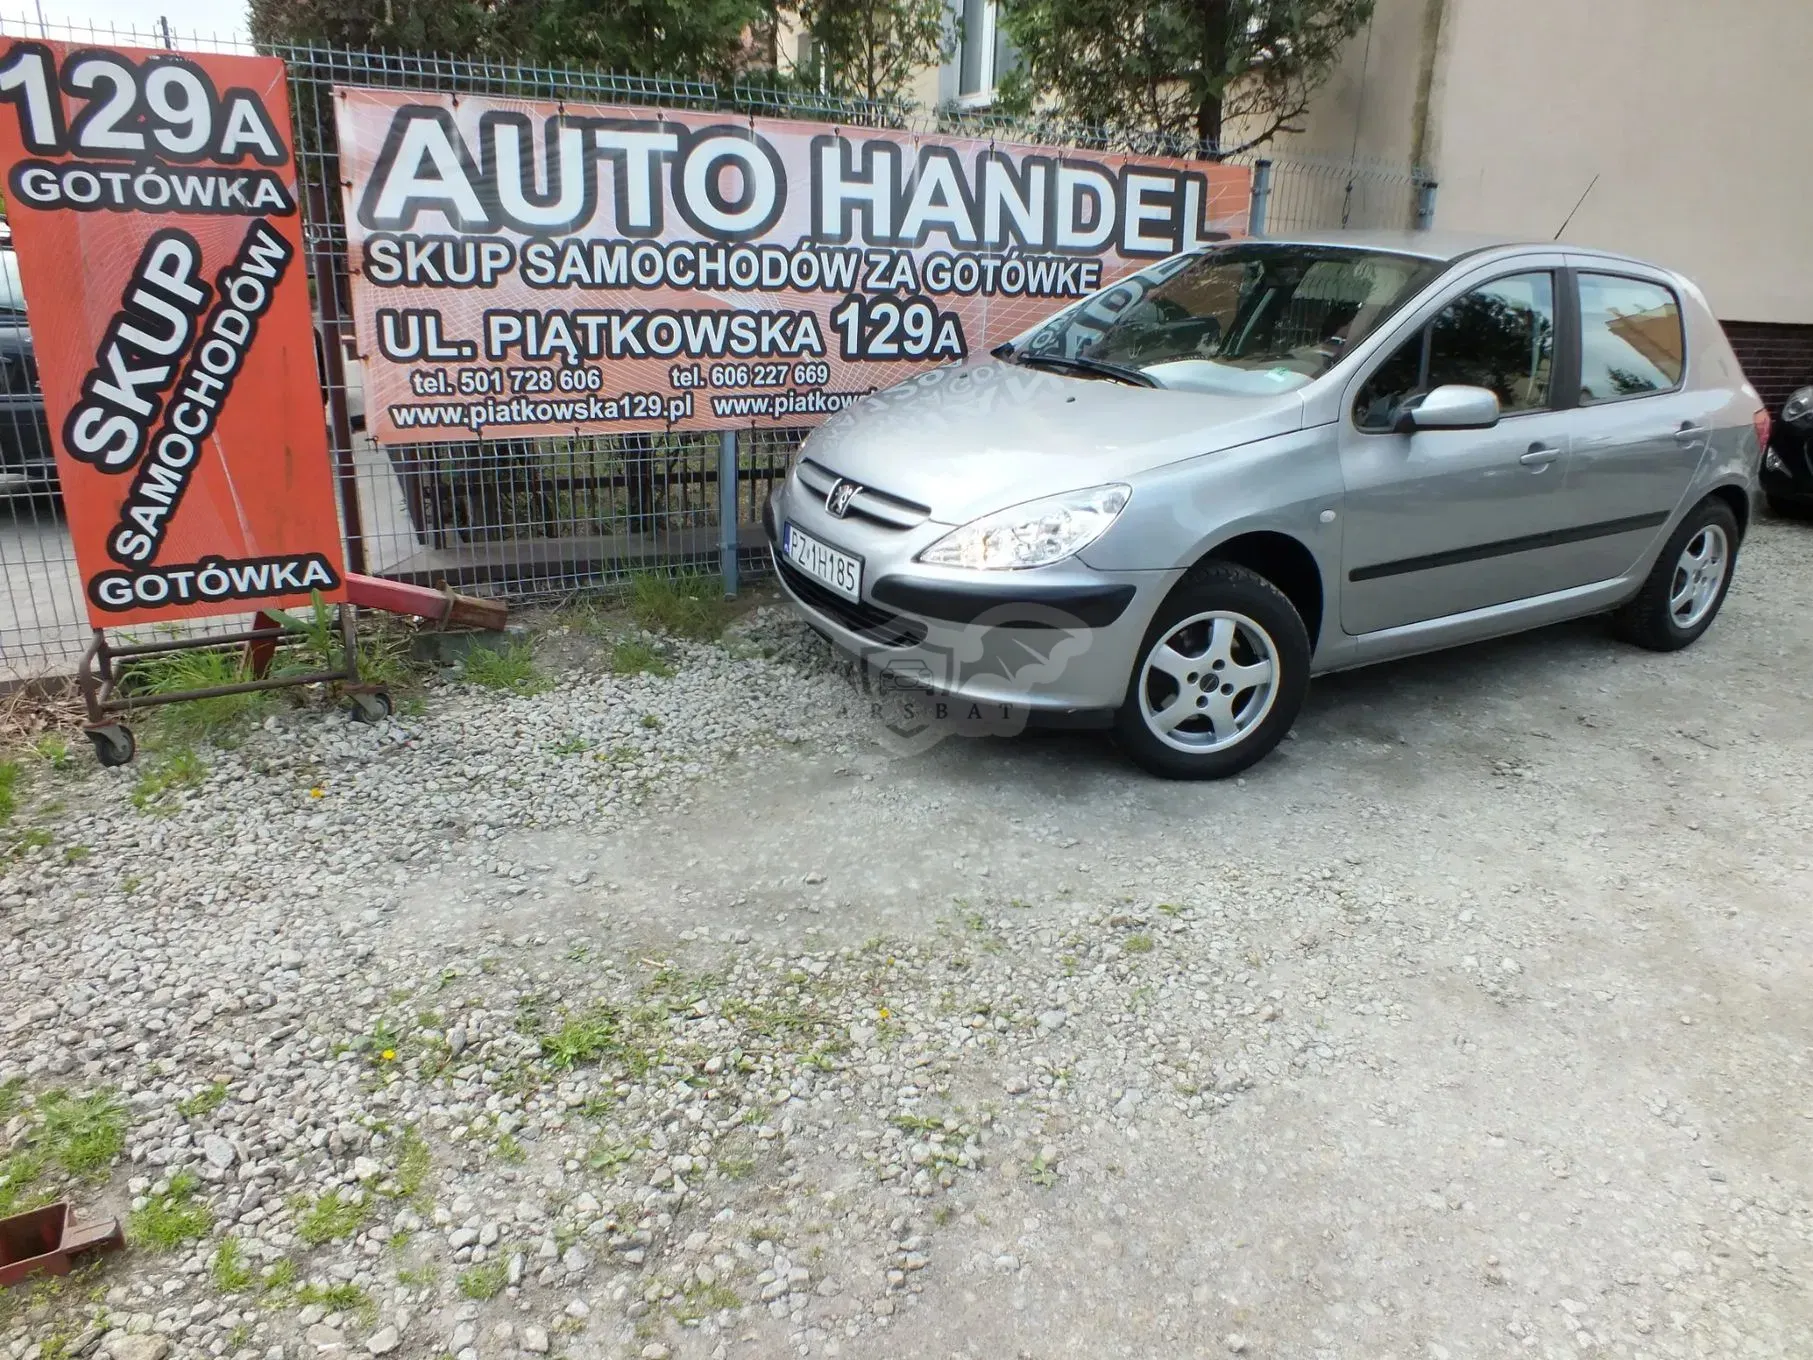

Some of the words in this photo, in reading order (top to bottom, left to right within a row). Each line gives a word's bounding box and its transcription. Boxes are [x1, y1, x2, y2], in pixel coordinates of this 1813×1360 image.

[0, 53, 279, 156] 129A
[20, 166, 286, 209] GOTÓWKA
[374, 118, 777, 232] AUTO
[821, 146, 1214, 254] HANDEL
[369, 240, 511, 284] SKUP
[525, 242, 857, 288] SAMOCHODÓW
[866, 254, 916, 291] ZA
[926, 249, 1099, 295] GOTÓWKE
[73, 238, 204, 465] SKUP
[382, 315, 472, 359] UL.
[490, 315, 822, 364] PIĄTKOWSKA
[836, 302, 962, 356] 129A
[116, 229, 286, 561] SAMOCHODÓW
[413, 372, 453, 394] tel.
[460, 371, 502, 392] 501
[510, 370, 552, 391] 728
[560, 369, 600, 389] 606
[672, 366, 705, 387] tel.
[712, 366, 748, 385] 606
[753, 365, 788, 385] 227
[794, 365, 828, 383] 669
[393, 394, 692, 428] www.piatkowska129.pl
[99, 560, 333, 605] GOTÓWKA
[790, 531, 806, 566] PZ
[812, 543, 855, 591] 1H185
